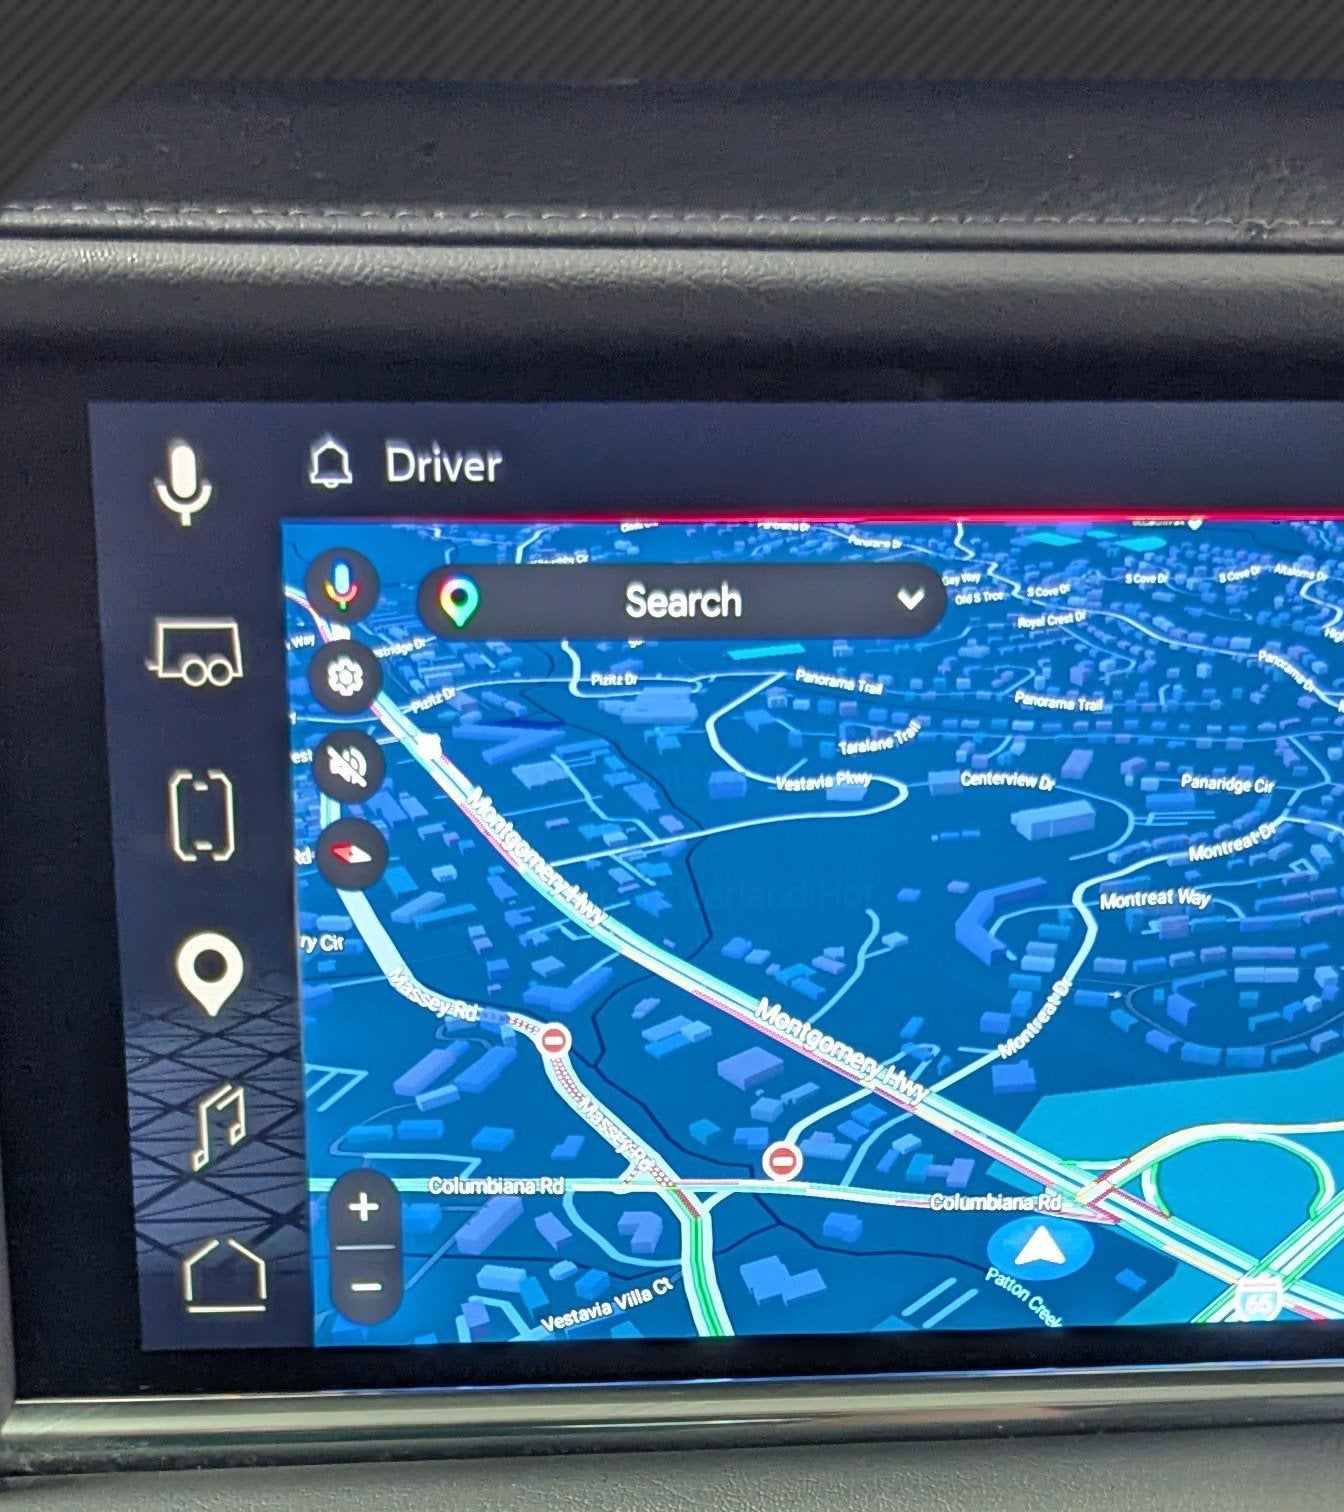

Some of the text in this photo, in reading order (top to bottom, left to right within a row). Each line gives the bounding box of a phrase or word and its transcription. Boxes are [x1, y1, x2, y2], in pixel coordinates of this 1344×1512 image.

[385, 439, 503, 485] Driver
[625, 580, 742, 618] Search
[795, 667, 884, 696] Panorama Trail
[1256, 650, 1316, 693] Panorama Dr
[1014, 690, 1105, 712] Panorama Trail
[838, 719, 921, 757] Taralane Trail
[775, 770, 873, 793] Vestavia Pkwy
[960, 769, 1056, 793] Centerview Dr
[1180, 774, 1276, 795] Panaridge Cir
[467, 785, 609, 927] Montgomery Hwy
[1188, 821, 1277, 862] Montreat Dr
[1099, 888, 1212, 911] Montreat Way
[320, 933, 345, 952] Cir
[388, 965, 479, 1022] Massey Rd
[997, 979, 1073, 1060] Montreat Dr
[756, 996, 932, 1105] Montgomery Hwy
[580, 1096, 636, 1154] Massey
[428, 1176, 565, 1195] Columbiana Rd
[929, 1191, 1064, 1211] Columbiana Rd
[540, 1275, 674, 1333] Vestavia Villa Ct
[985, 1267, 1064, 1328] Patton Creek
